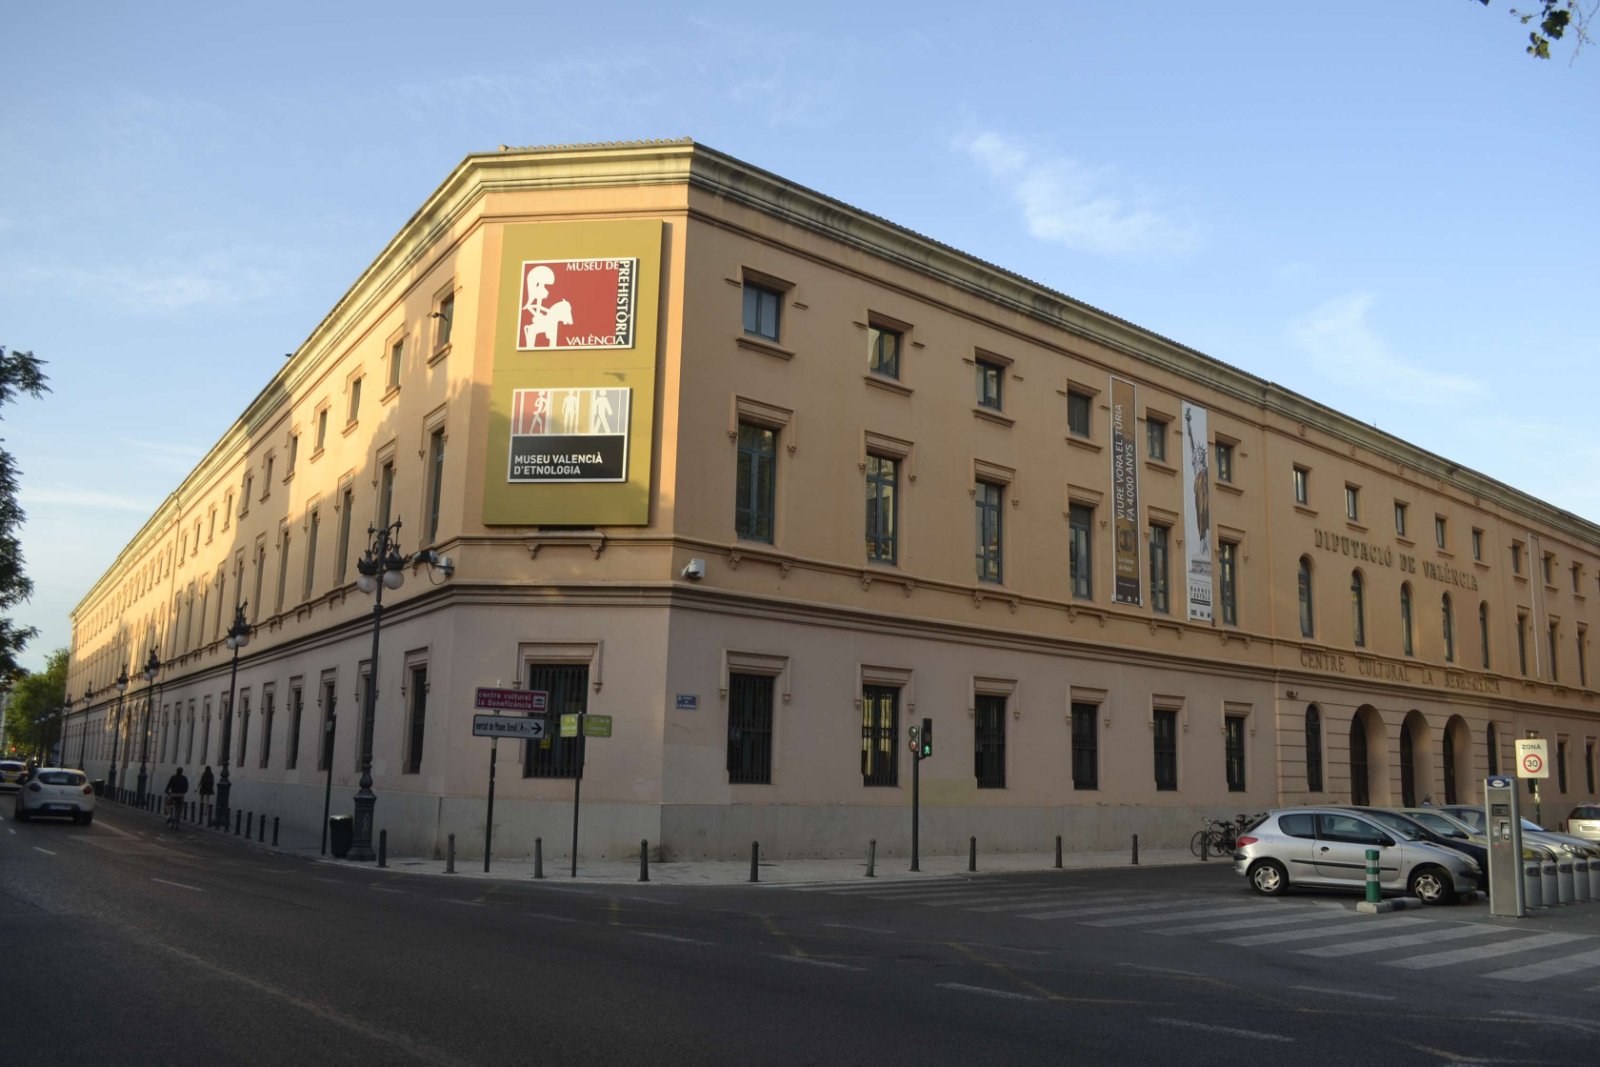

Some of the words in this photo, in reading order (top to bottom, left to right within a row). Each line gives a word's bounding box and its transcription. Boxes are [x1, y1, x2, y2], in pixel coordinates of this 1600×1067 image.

[566, 261, 603, 272] MUSEU
[605, 260, 620, 271] DE
[566, 334, 625, 346] VALÈNCIA
[1113, 404, 1123, 435] TÚRIA
[1115, 439, 1123, 453] EL
[514, 455, 550, 464] MUSEU
[552, 452, 603, 464] VALENCIÀ
[1115, 454, 1124, 484] VORA
[1125, 444, 1134, 476] ANYS
[513, 466, 581, 475] D'ETNOLOGIA
[1116, 486, 1125, 520] VIURE
[1126, 507, 1135, 522] FA
[1314, 528, 1393, 568] DIPUTACIÓ
[1400, 554, 1416, 574] DE
[1301, 651, 1346, 673] CENTRE
[1358, 658, 1410, 682] CULTURAL
[1422, 668, 1434, 686] LA
